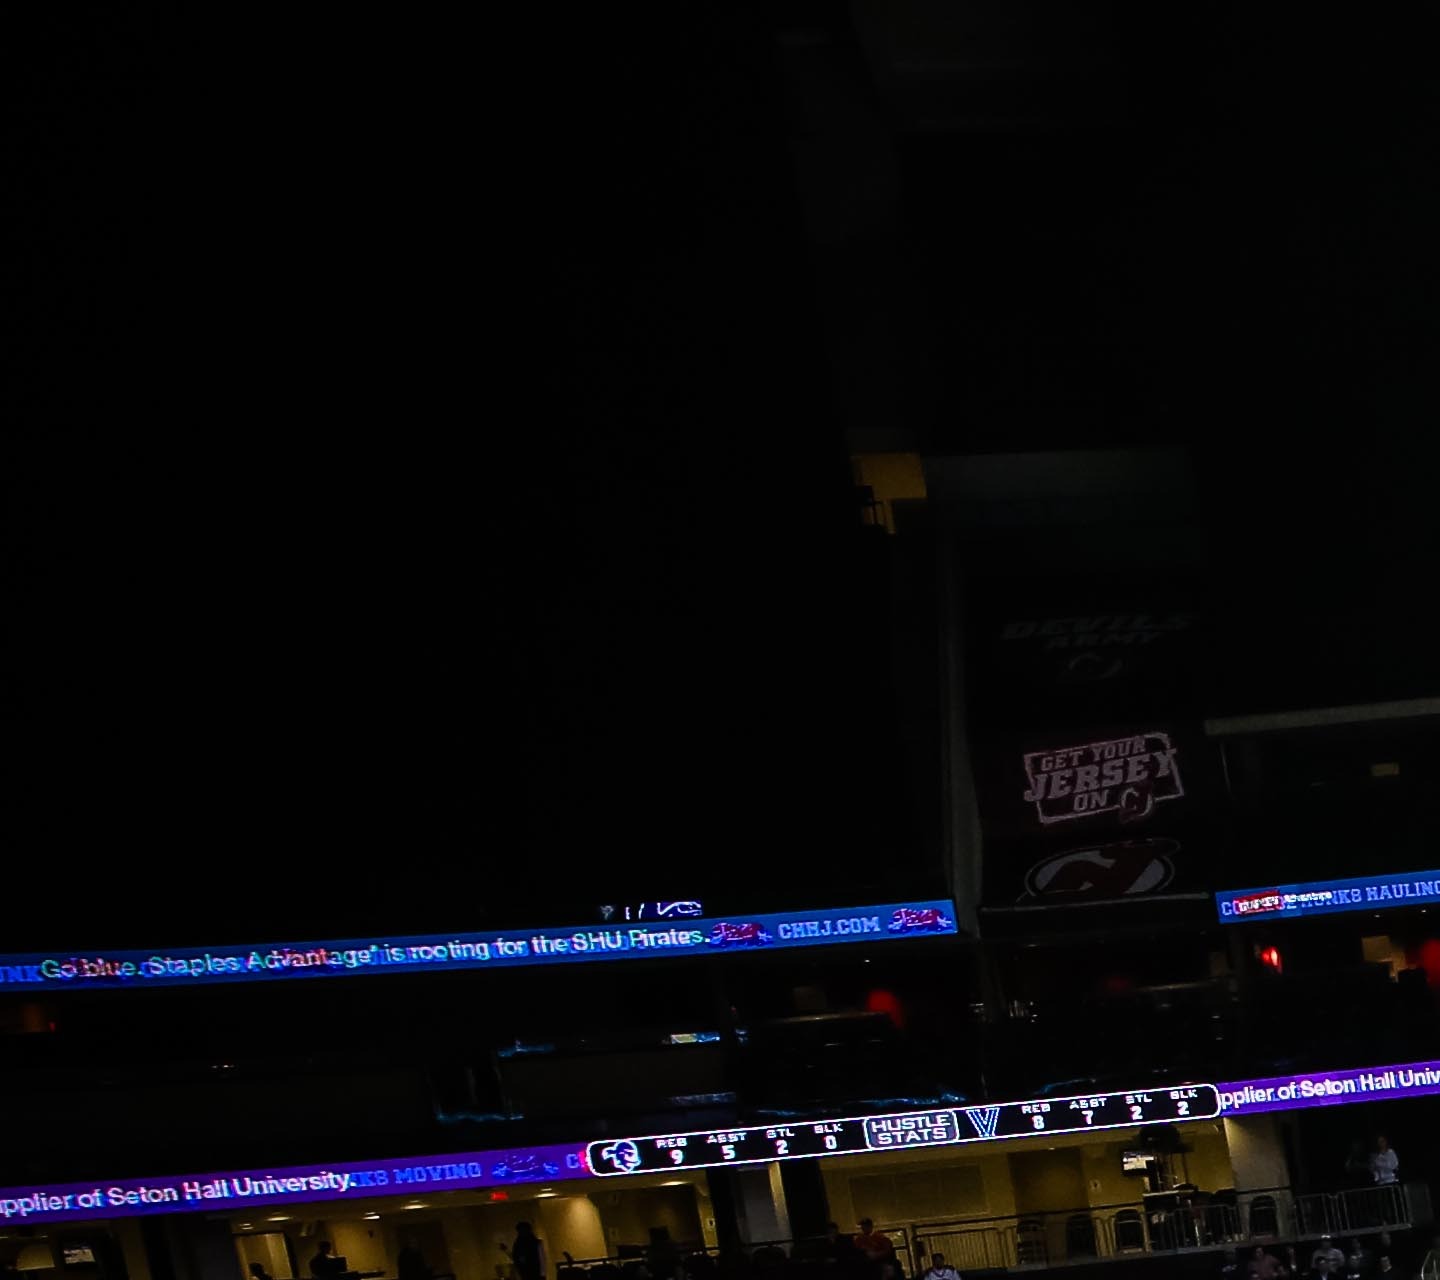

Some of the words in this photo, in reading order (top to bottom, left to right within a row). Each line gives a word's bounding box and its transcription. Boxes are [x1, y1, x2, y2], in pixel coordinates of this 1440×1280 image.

[1040, 749, 1083, 772] GET
[1090, 736, 1147, 762] YOUR
[1023, 747, 1178, 802] JERSEY
[1073, 788, 1108, 813] ON
[150, 954, 239, 978] Staples
[384, 945, 406, 962] is
[411, 939, 490, 962] rooting
[496, 937, 528, 955] for
[532, 935, 569, 953] the
[573, 931, 621, 950] SHU
[631, 927, 710, 948] Pirates.
[1278, 1082, 1298, 1101] of
[1300, 1077, 1356, 1099] Seton
[1360, 1071, 1397, 1092] Hall
[1021, 1102, 1051, 1114] REB
[1082, 1110, 1095, 1125] 7
[1131, 1105, 1142, 1120] 2
[1177, 1101, 1188, 1116] 2
[871, 1114, 951, 1133] HUSTLE
[877, 1126, 947, 1144] STATS
[656, 1137, 687, 1150] REB
[672, 1149, 684, 1164] 9
[722, 1145, 734, 1160] 5
[777, 1140, 788, 1154] 2
[78, 1190, 104, 1209] of
[108, 1185, 178, 1206] Seton
[184, 1179, 230, 1199] Hall
[234, 1171, 357, 1197] University.
